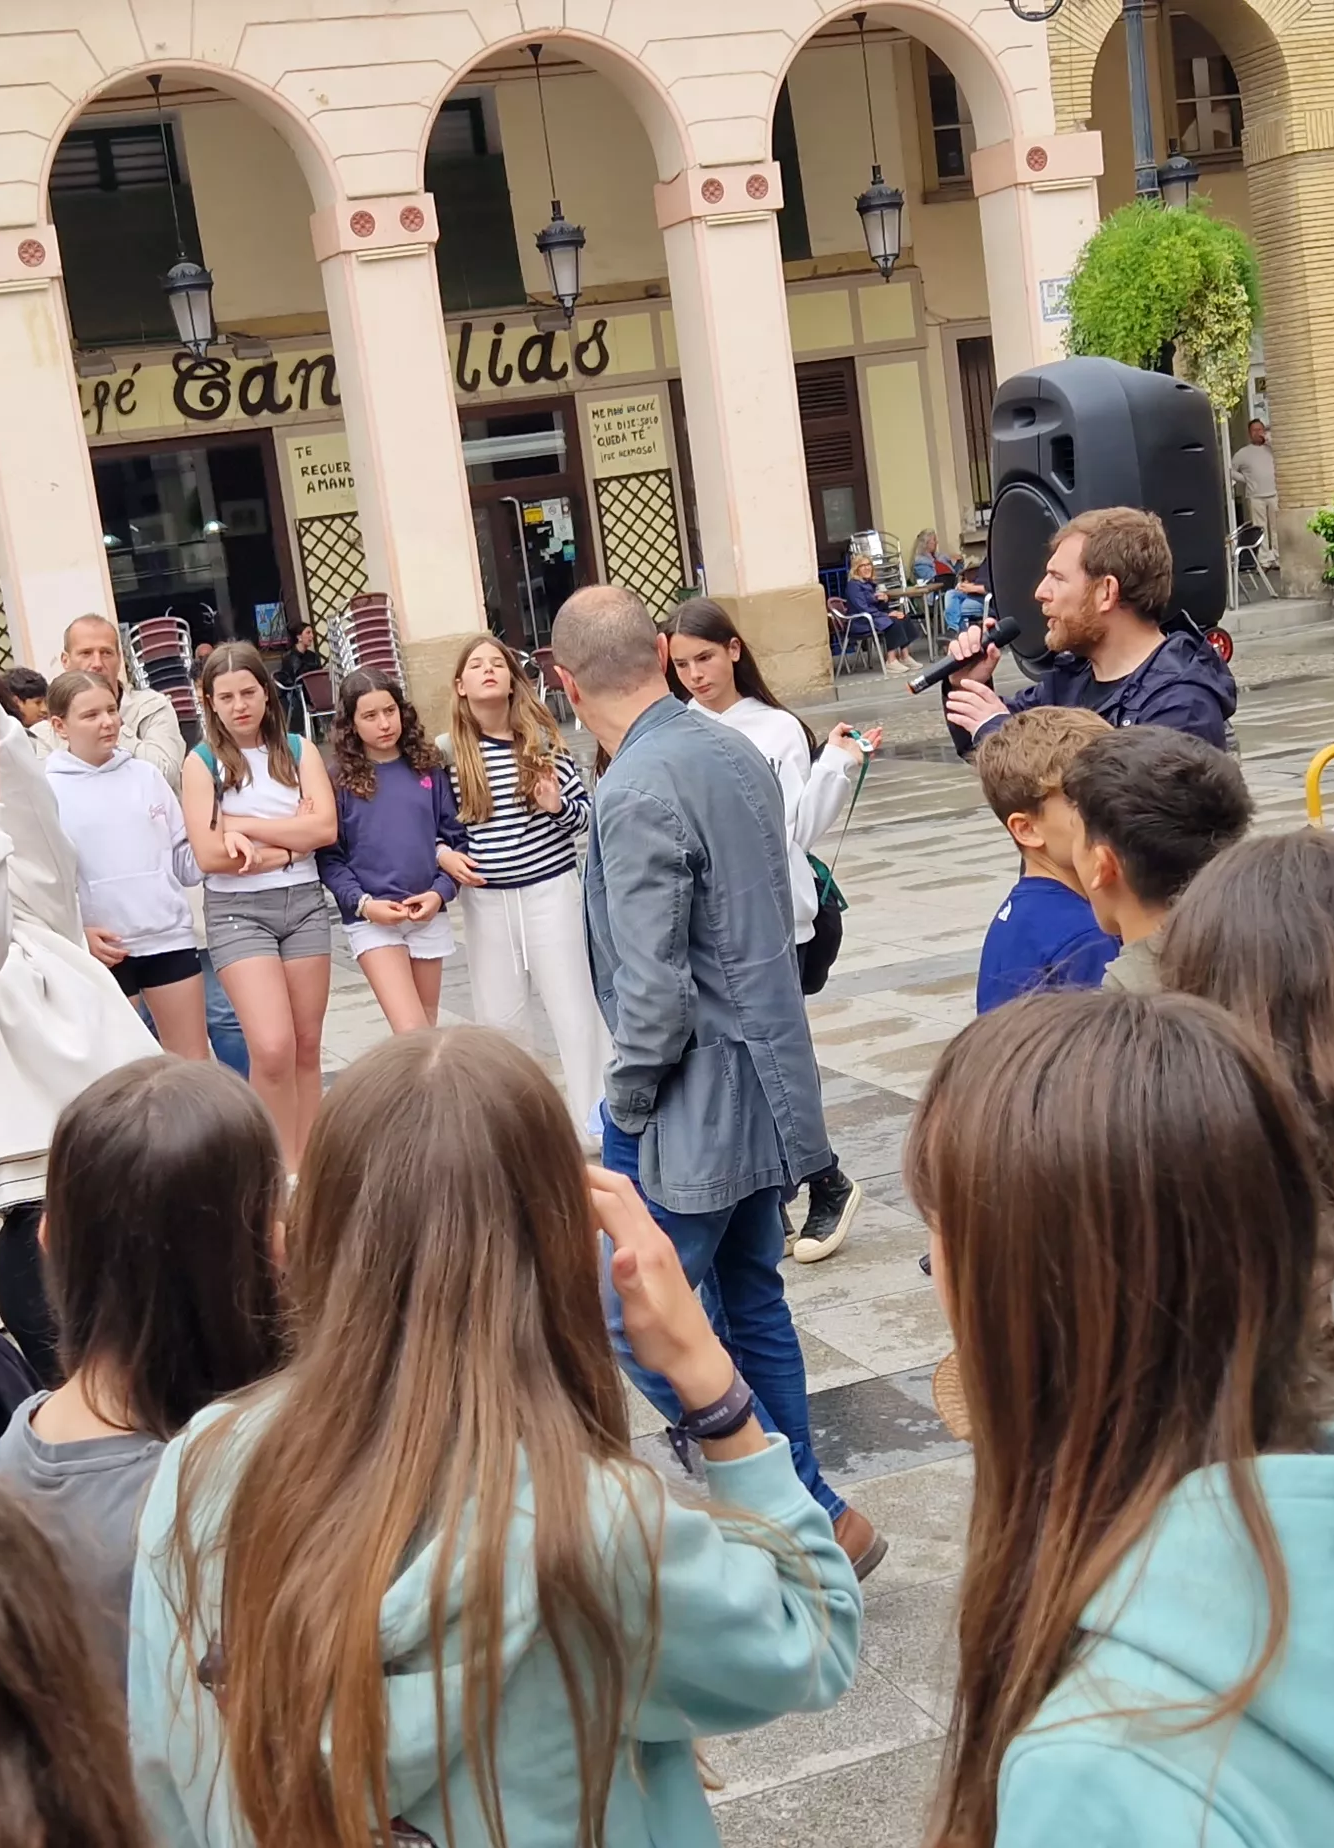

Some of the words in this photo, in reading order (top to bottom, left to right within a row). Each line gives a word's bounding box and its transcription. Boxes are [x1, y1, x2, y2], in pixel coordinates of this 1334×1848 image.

[591, 409, 607, 420] ME
[604, 422, 613, 431] LE
[294, 445, 313, 459] TE
[300, 461, 352, 477] RECUER
[307, 477, 355, 495] AMAND
